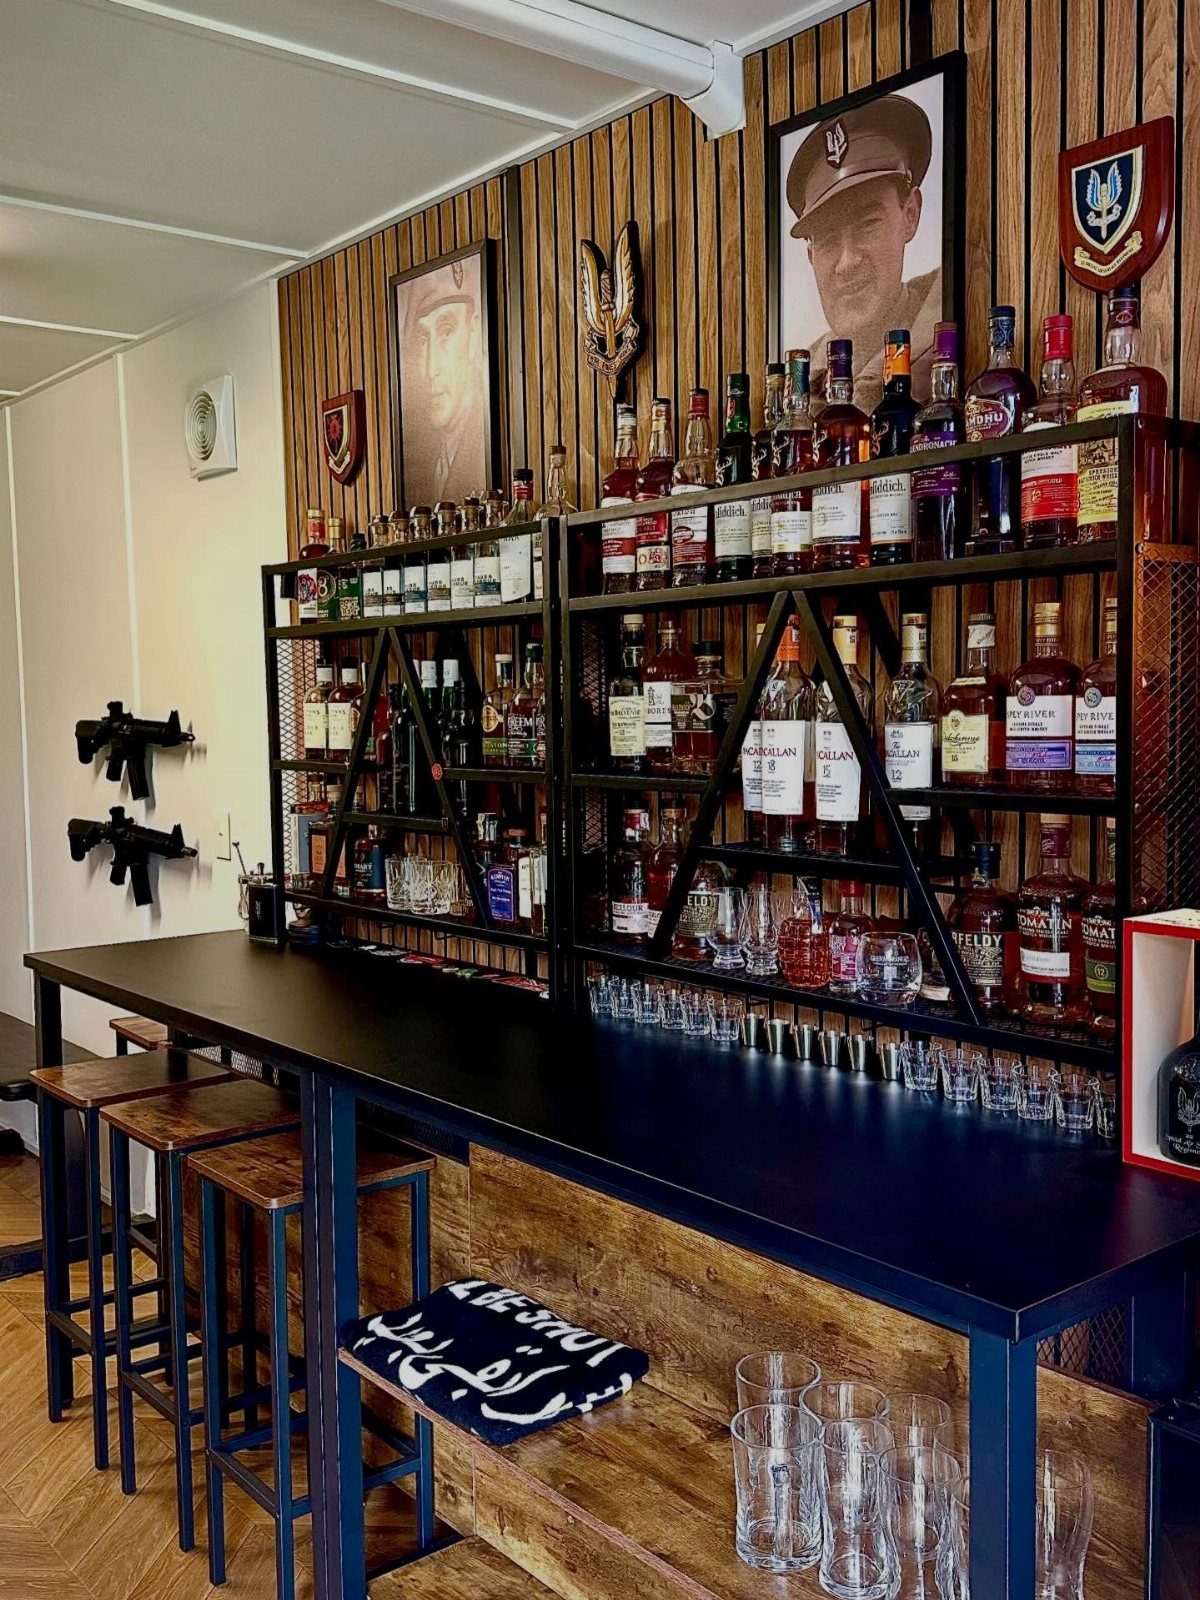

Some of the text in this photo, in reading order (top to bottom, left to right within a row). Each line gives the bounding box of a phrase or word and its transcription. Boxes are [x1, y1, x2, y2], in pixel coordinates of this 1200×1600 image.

[716, 504, 747, 518] fiddich.
[767, 759, 776, 772] 18
[891, 769, 902, 781] 12
[1017, 913, 1072, 930] TOMATIN
